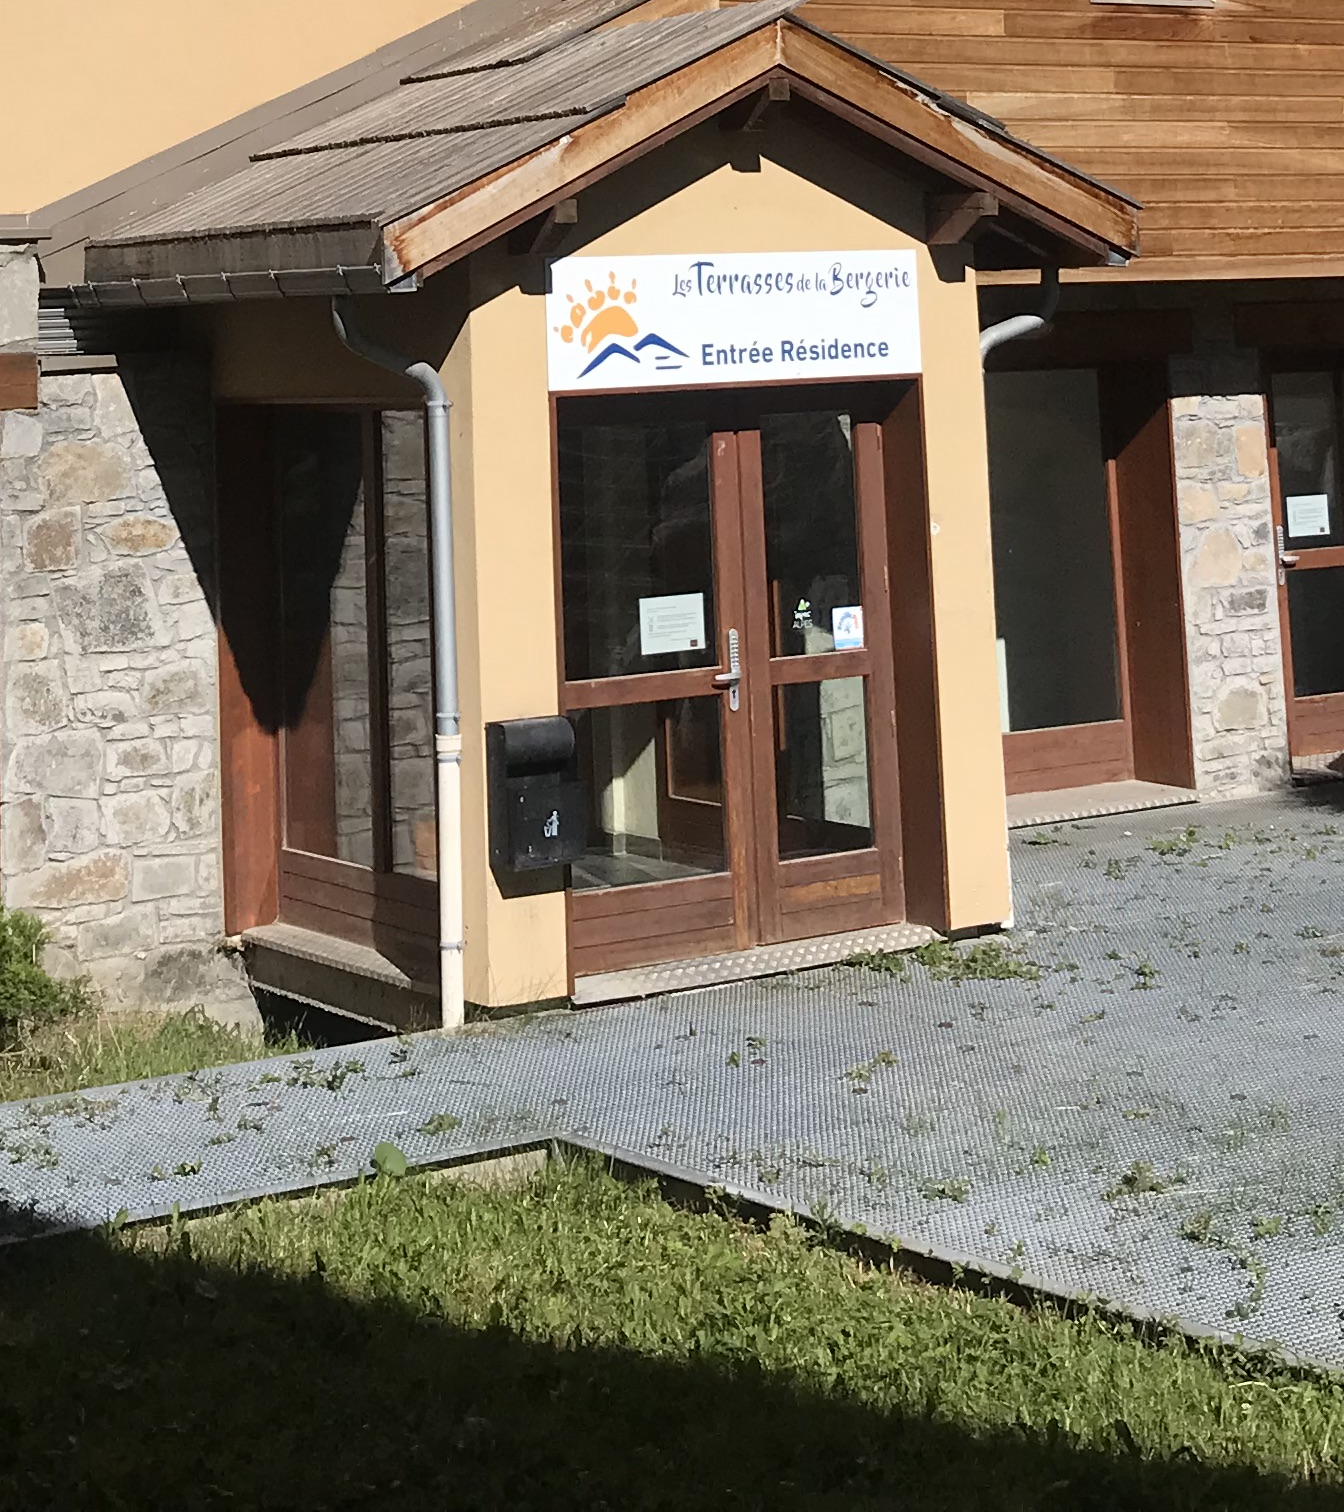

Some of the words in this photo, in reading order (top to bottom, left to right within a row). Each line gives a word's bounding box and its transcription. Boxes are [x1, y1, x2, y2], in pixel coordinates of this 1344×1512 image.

[672, 273, 692, 298] Les
[688, 261, 794, 296] Terrasses
[797, 273, 811, 292] de
[816, 272, 827, 292] la
[828, 262, 911, 308] Bergerie
[702, 341, 773, 365] Entrée
[781, 338, 889, 362] Résidence
